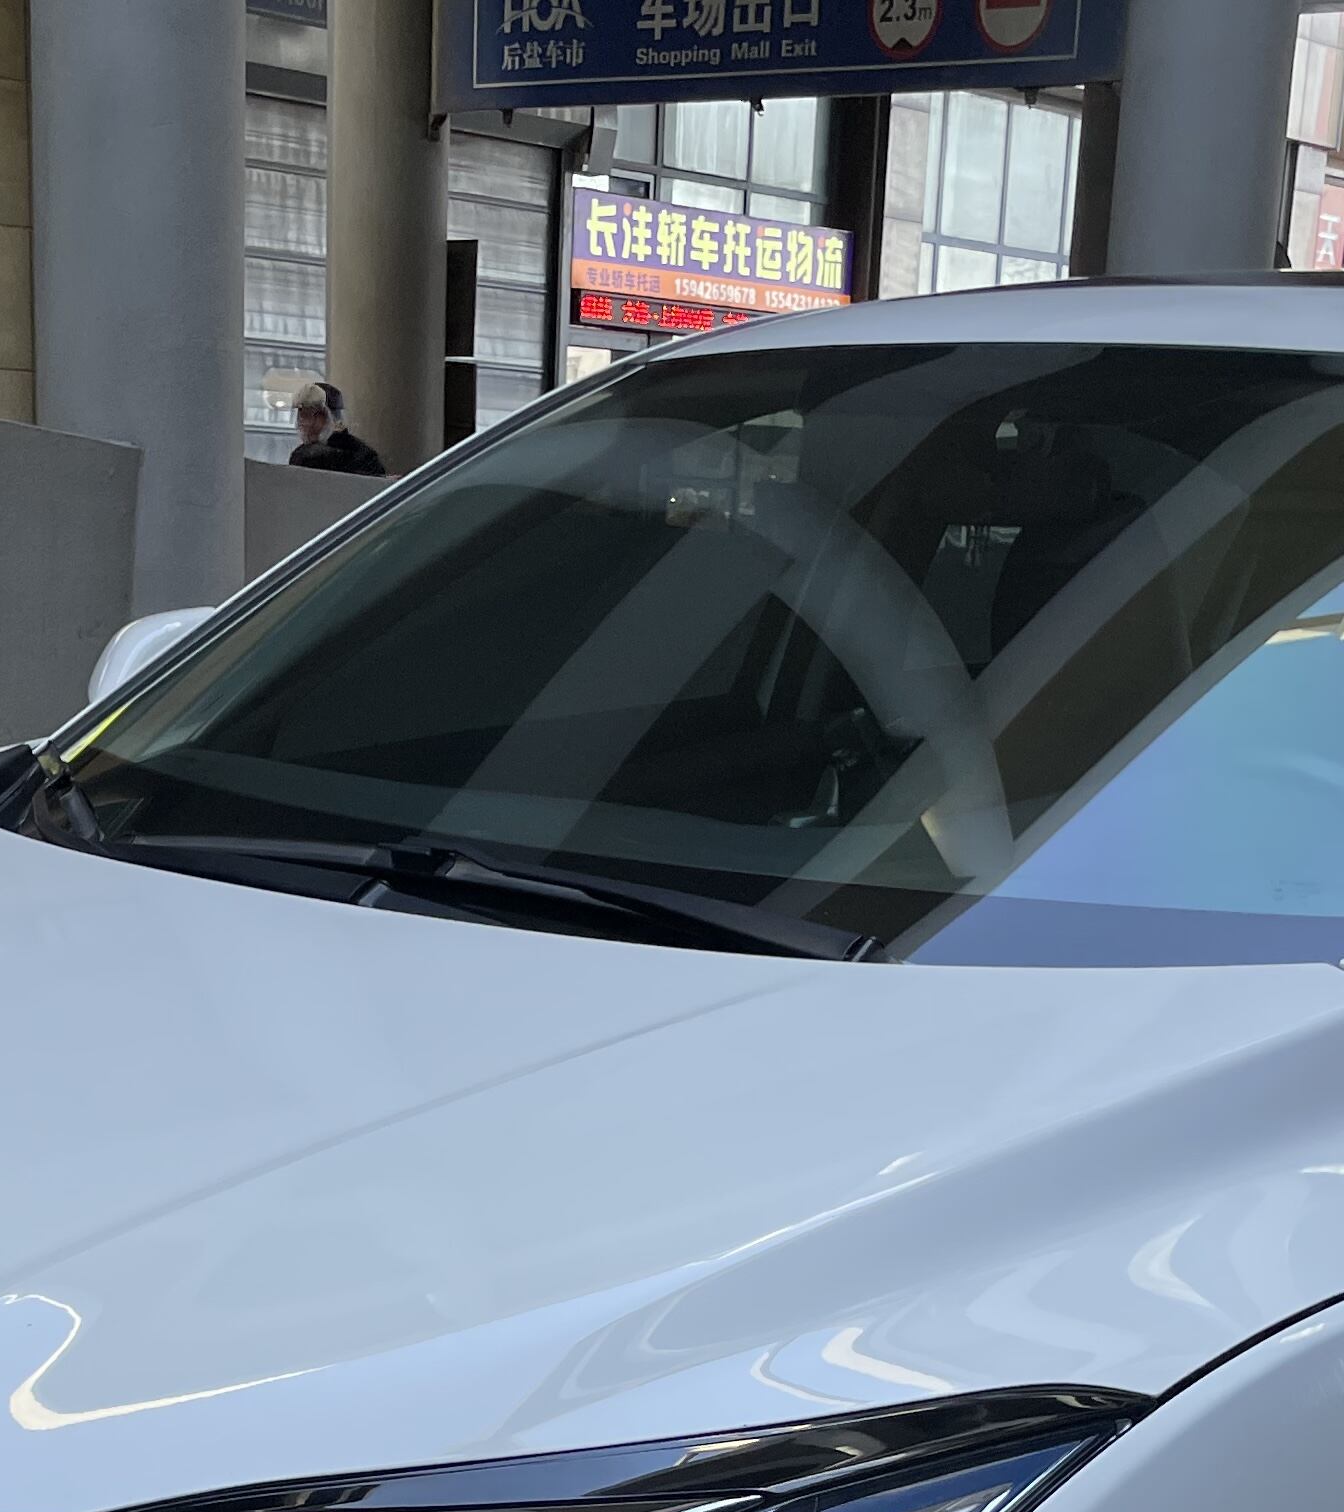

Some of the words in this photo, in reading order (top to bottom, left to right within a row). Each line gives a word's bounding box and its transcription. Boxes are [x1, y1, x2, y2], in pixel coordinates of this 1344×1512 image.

[501, 39, 585, 70] 后盐车市
[636, 46, 721, 66] Shopping
[731, 41, 770, 60] Mall
[781, 39, 817, 57] Exit
[586, 198, 844, 290] 长沣轿车托运物流
[586, 266, 661, 293] 专业轿车托运
